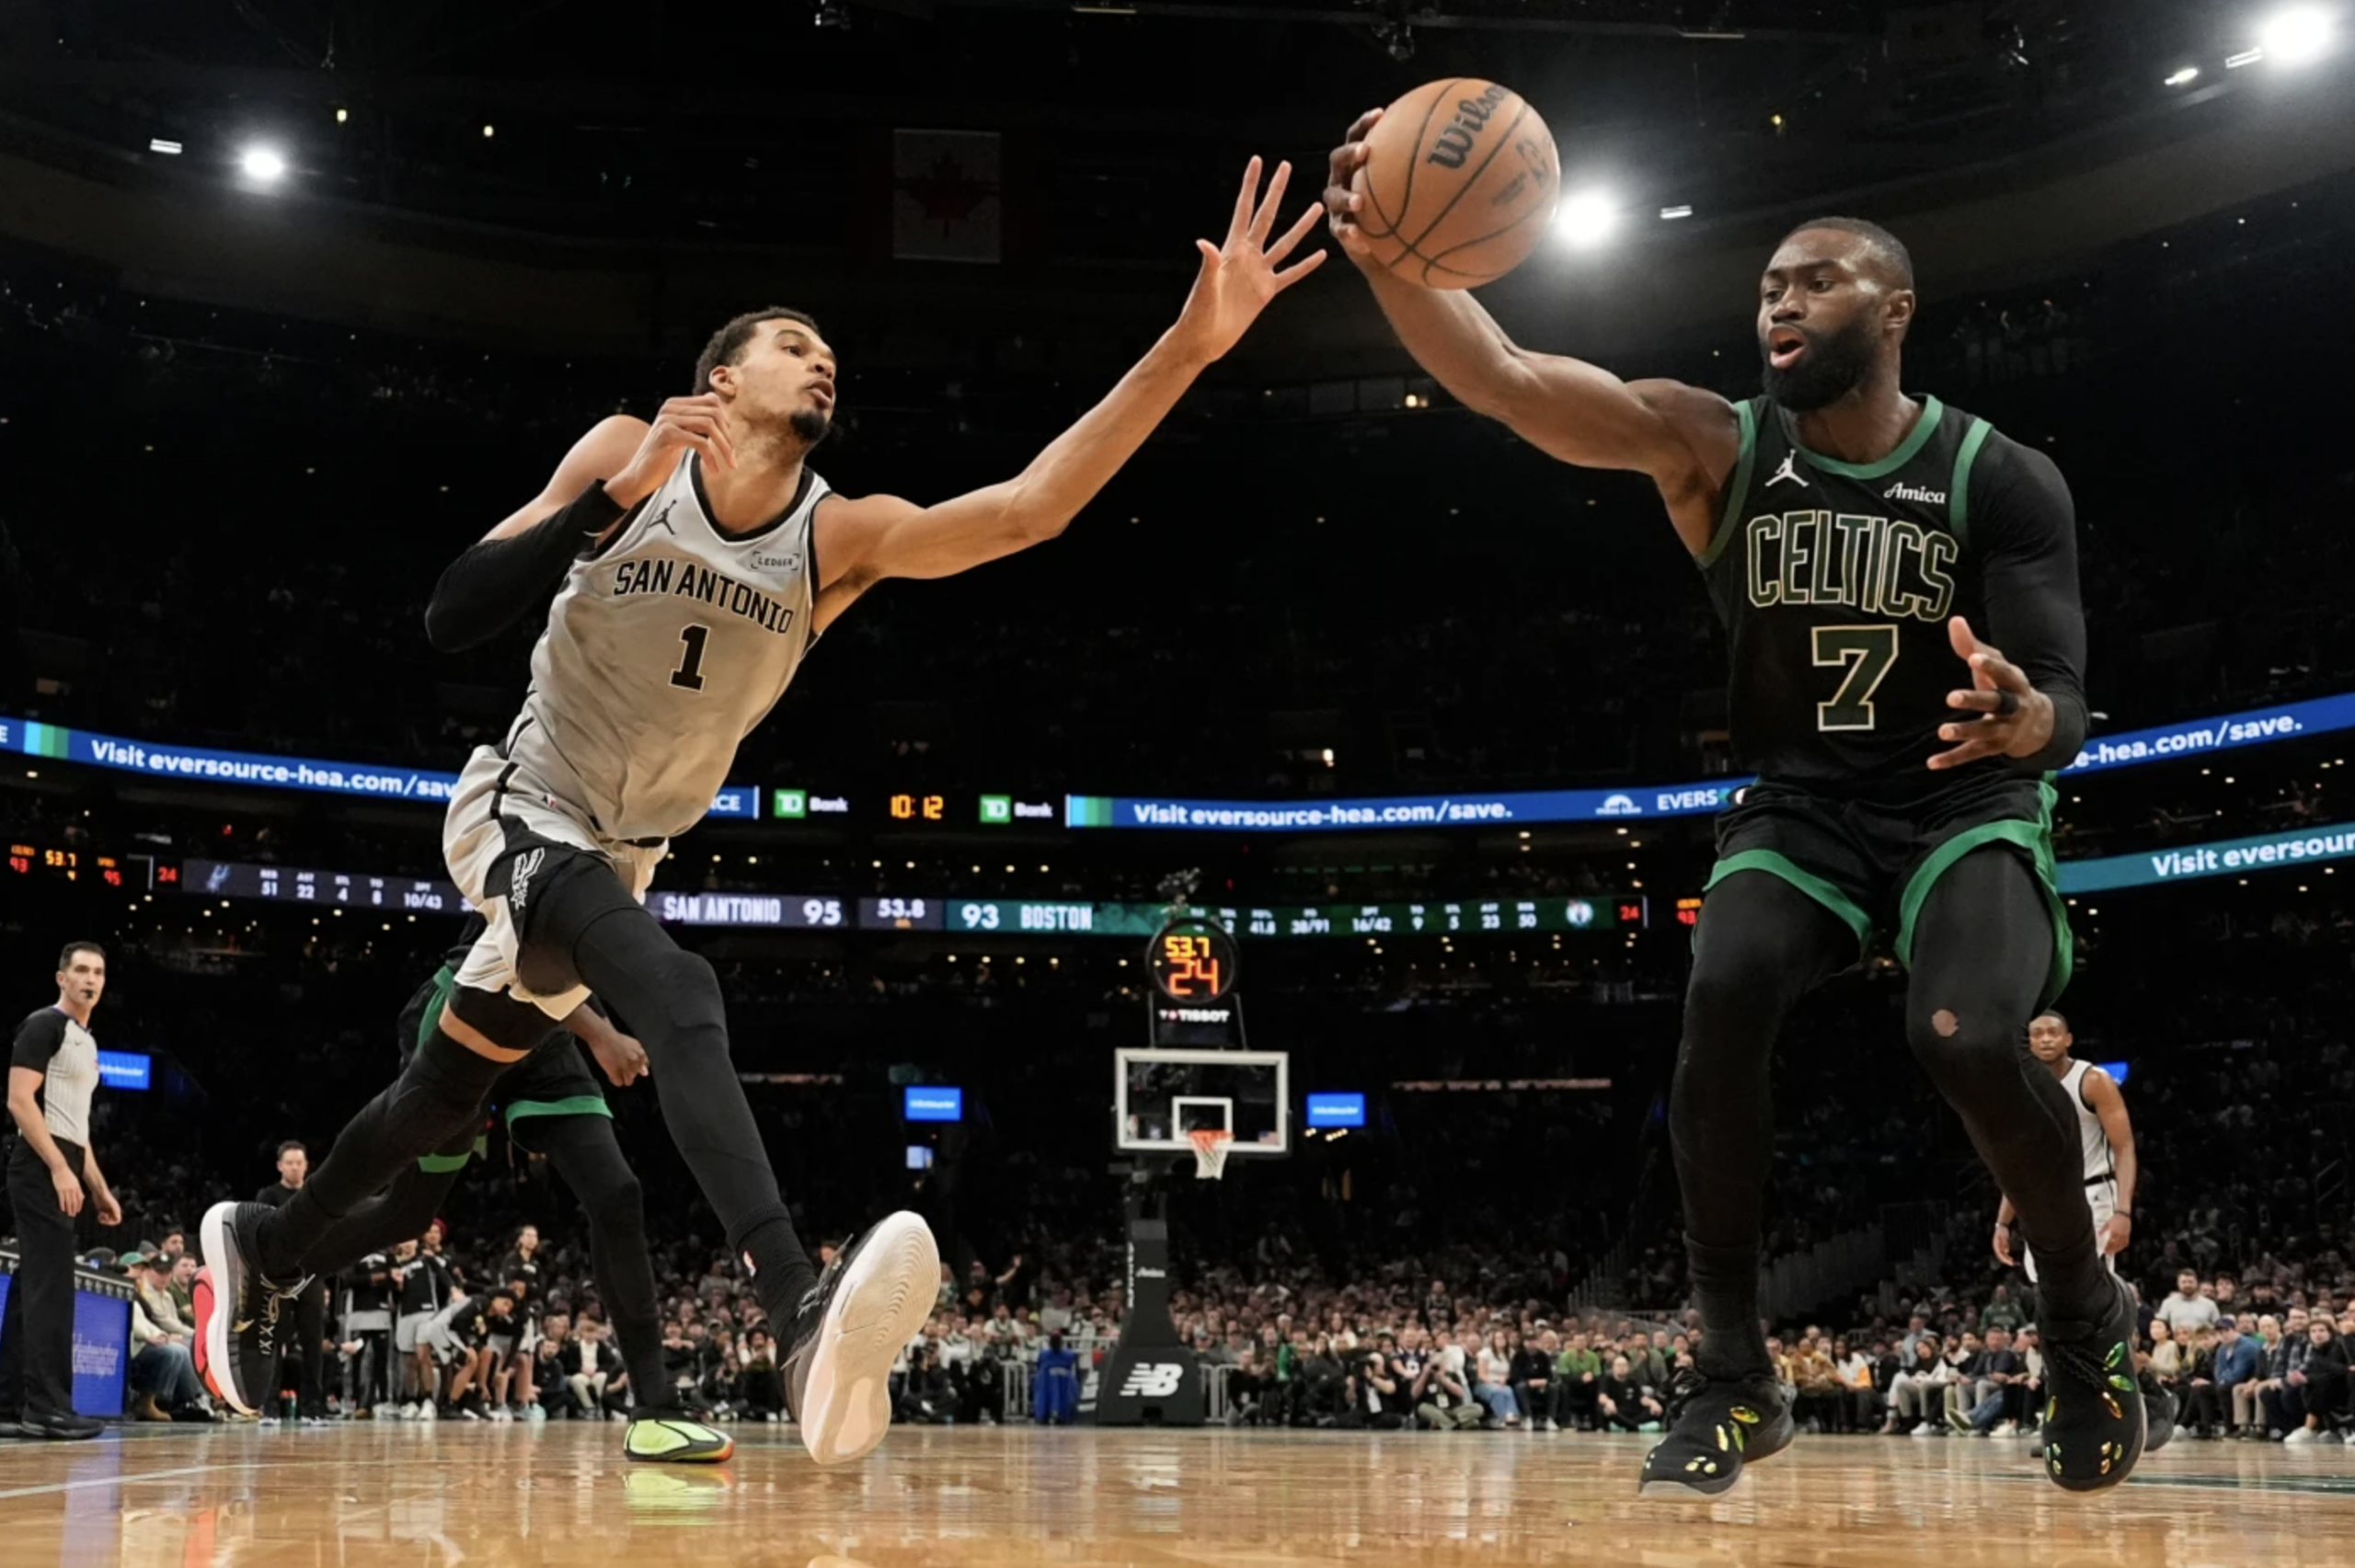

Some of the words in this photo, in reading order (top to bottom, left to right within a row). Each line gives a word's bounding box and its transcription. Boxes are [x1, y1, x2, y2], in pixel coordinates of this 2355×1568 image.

[1427, 85, 1511, 169] Wilso
[1883, 482, 1946, 504] Amica
[757, 555, 794, 567] LEDGER
[1746, 509, 1959, 623] CELTICS
[613, 559, 674, 596] SAN
[674, 563, 795, 635] ANTONIO
[668, 622, 710, 693] 1
[1810, 624, 1899, 732] 7
[91, 739, 145, 768] Visit
[2067, 715, 2303, 770] e-hea.com/save.
[778, 794, 803, 812] TD
[809, 797, 848, 812] Bank
[983, 799, 1008, 818] TD
[1014, 802, 1052, 818] Bank
[1133, 804, 1188, 824] Visit
[1190, 800, 1512, 827] eversource-hea.com/save.
[158, 867, 177, 881] 24
[2152, 849, 2218, 876] Visit
[297, 884, 315, 899] 22
[338, 887, 349, 902] 4
[403, 892, 443, 910] 10/43
[662, 895, 700, 922] SAN
[703, 896, 781, 923] ANTONIO
[802, 898, 842, 926] 95
[877, 898, 925, 918] 53.8
[961, 903, 1000, 929] 93
[1020, 904, 1093, 931] BOSTON
[1620, 905, 1639, 921] 24
[1165, 935, 1210, 958] 53.7
[1167, 958, 1219, 995] 24
[1178, 1009, 1230, 1023] TISSOT
